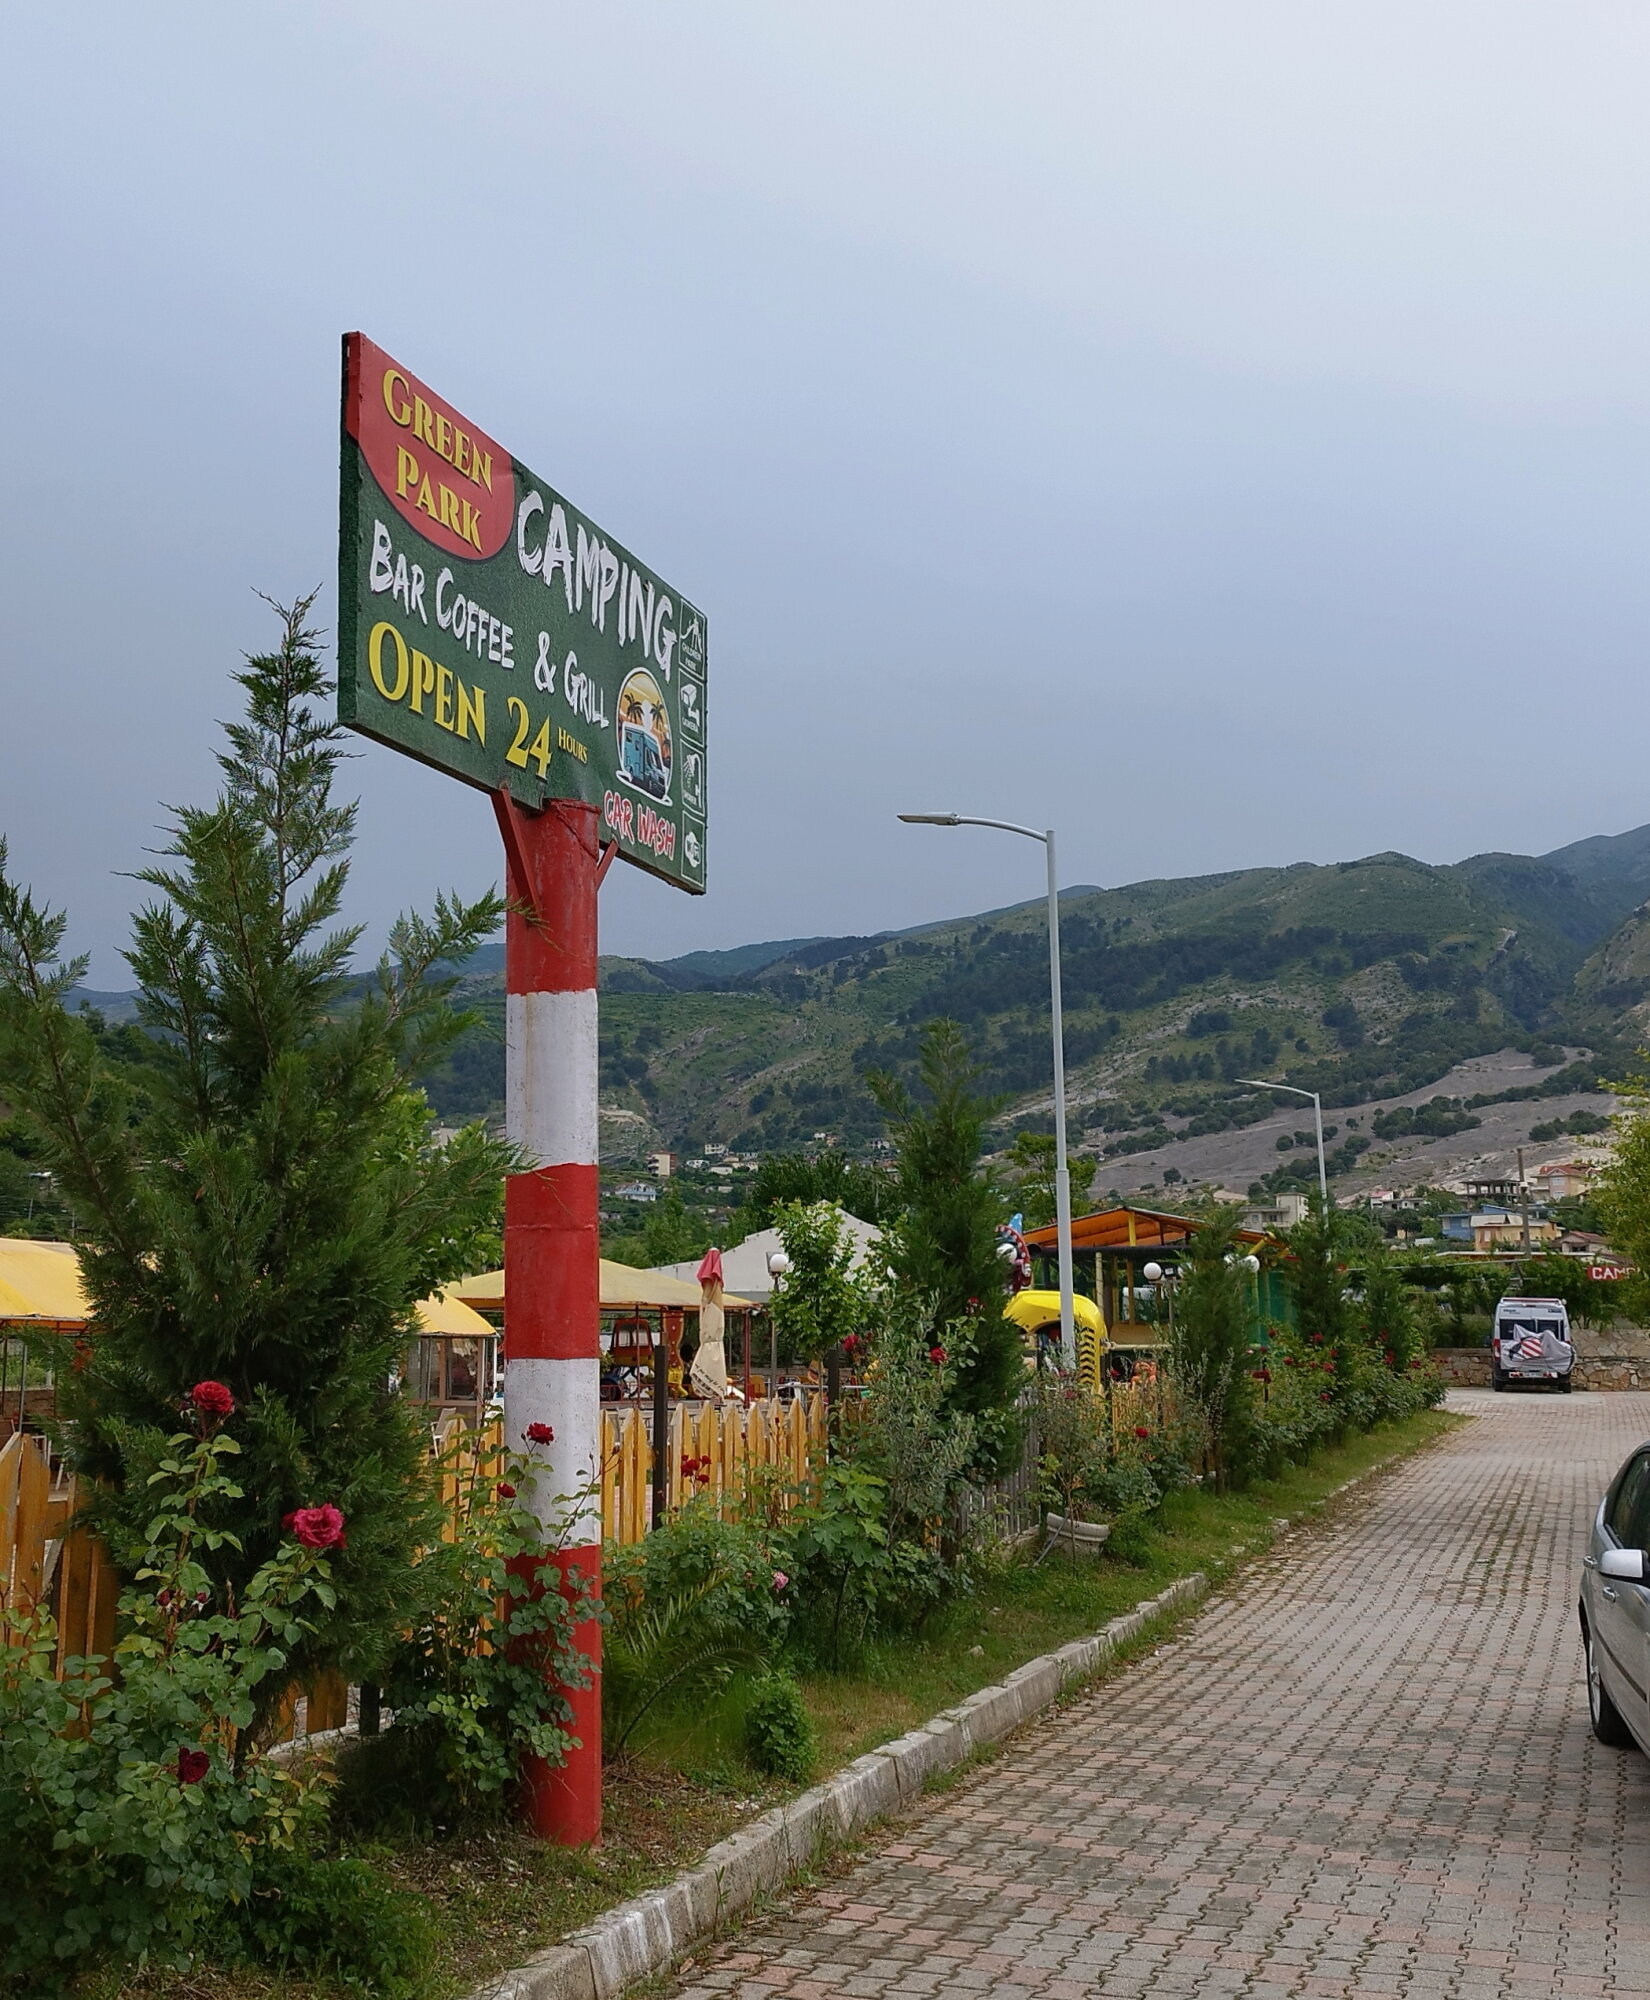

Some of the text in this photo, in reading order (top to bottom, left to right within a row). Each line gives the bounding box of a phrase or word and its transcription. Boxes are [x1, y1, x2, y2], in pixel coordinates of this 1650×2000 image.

[383, 369, 493, 497] GREEN
[395, 444, 483, 554] PARK
[369, 519, 515, 669] BAR COFFEE
[517, 489, 678, 684] CAMPING
[368, 620, 588, 781] OPEN 24 HOURS
[534, 630, 610, 728] & GRILL
[604, 789, 677, 861] CAR WASH
